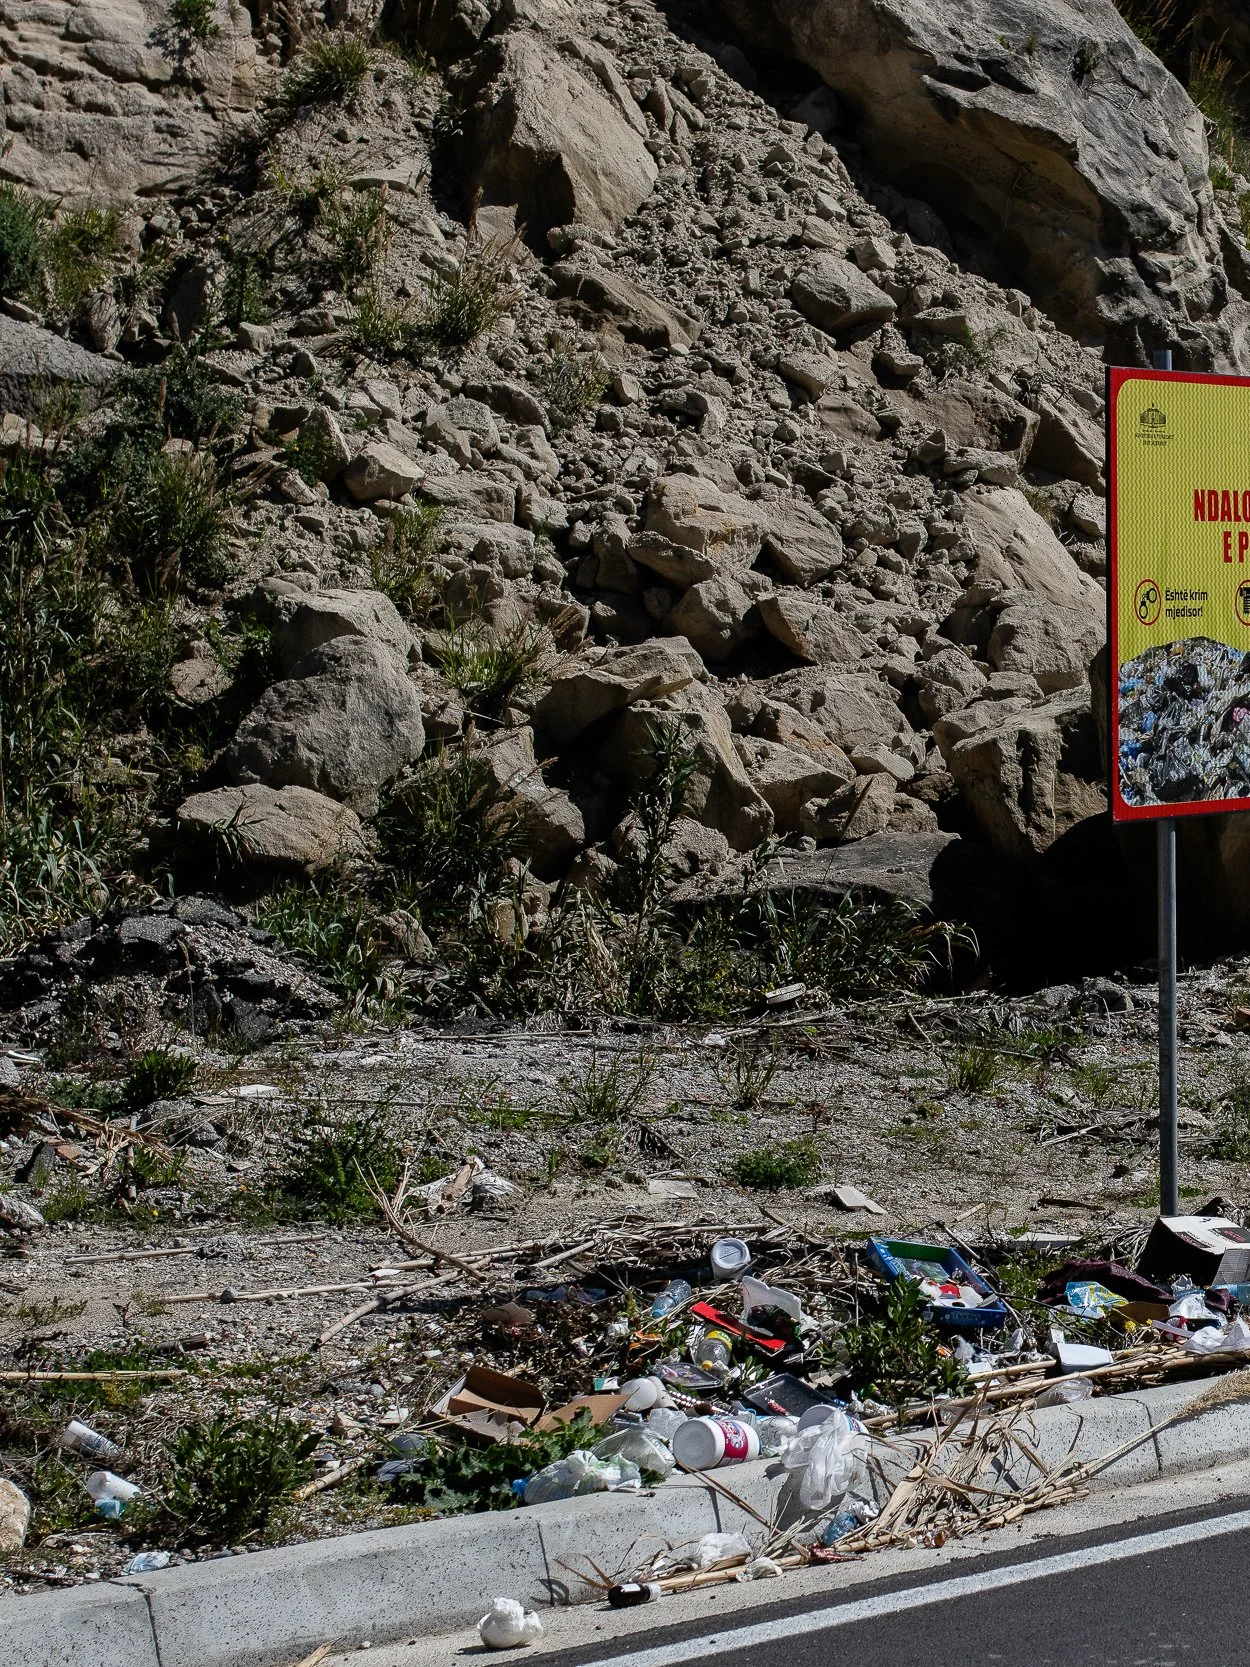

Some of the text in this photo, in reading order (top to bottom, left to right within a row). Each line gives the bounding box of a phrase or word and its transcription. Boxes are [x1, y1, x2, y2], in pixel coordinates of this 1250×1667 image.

[1223, 531, 1232, 563] E
[1165, 587, 1208, 600] Është krim
[1165, 605, 1203, 620] mjedisor!
